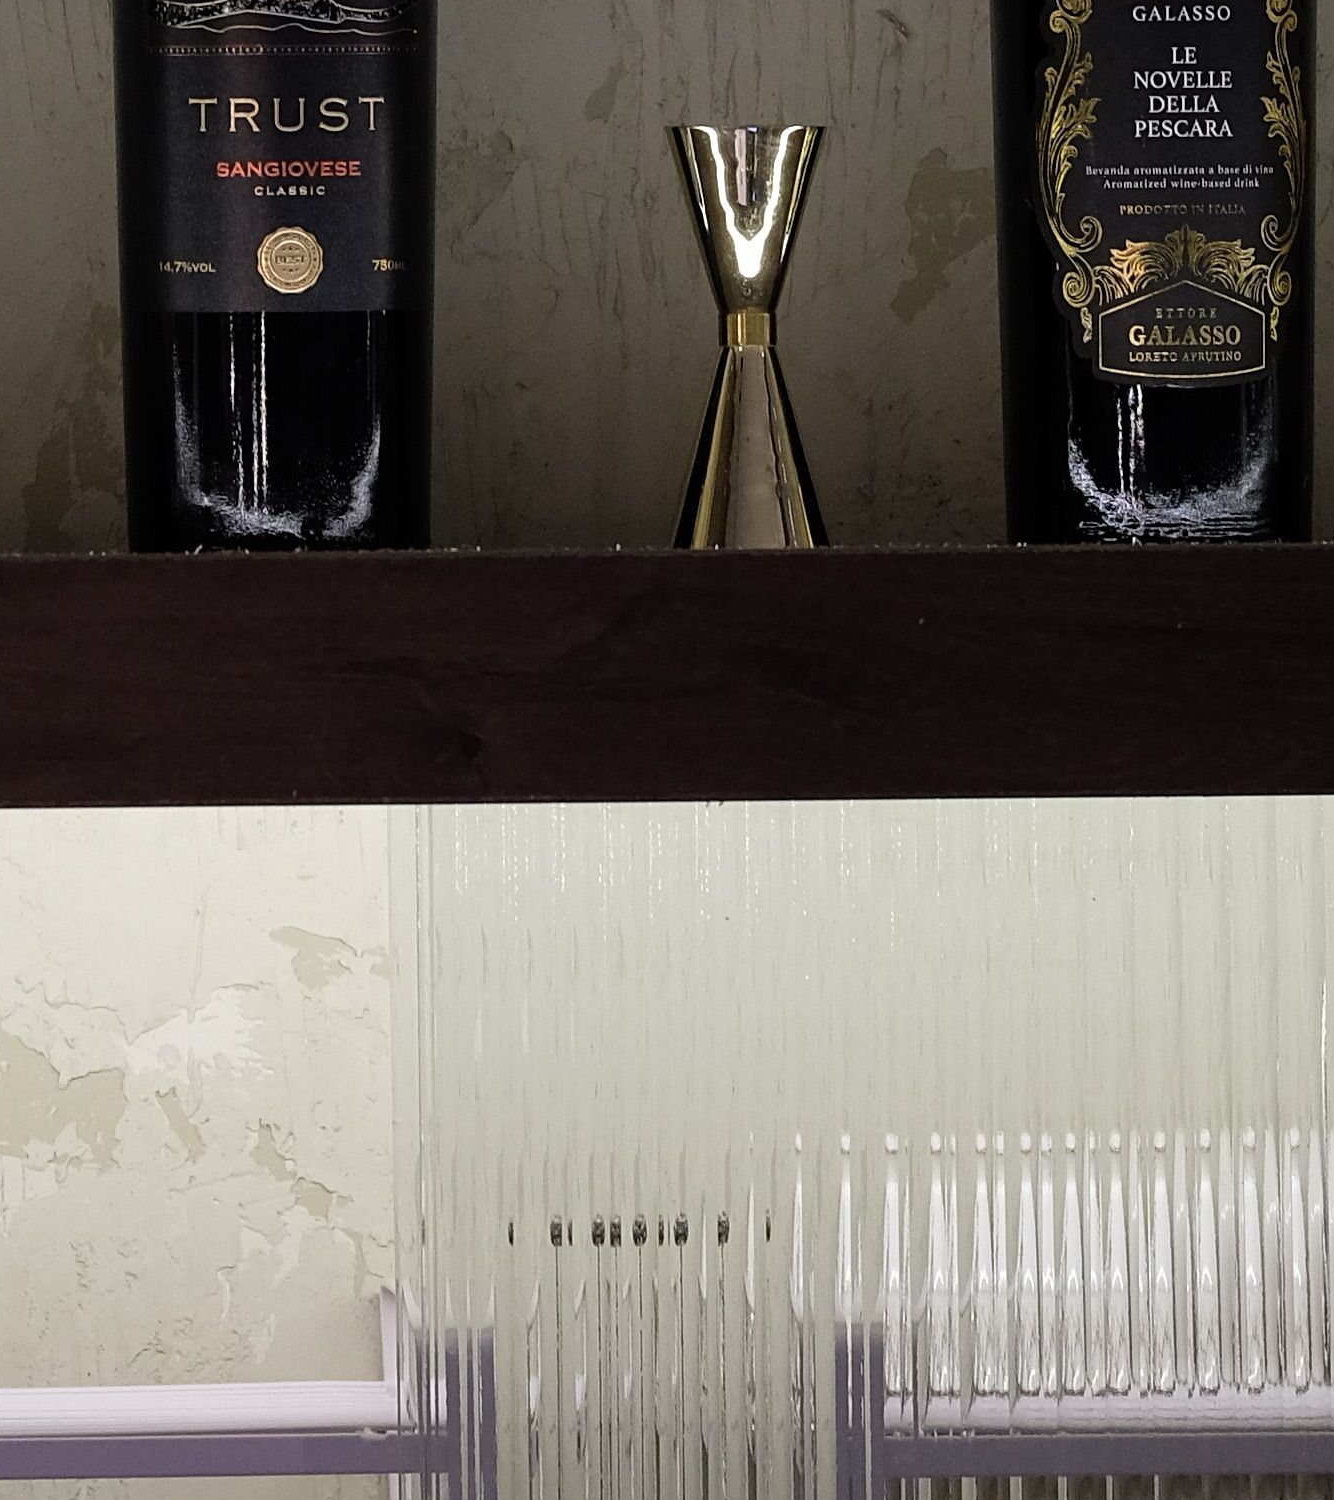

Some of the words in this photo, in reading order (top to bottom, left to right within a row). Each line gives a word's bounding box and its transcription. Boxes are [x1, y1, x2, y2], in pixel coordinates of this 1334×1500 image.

[1132, 4, 1232, 23] GALASSO
[1170, 47, 1197, 65] LE
[1133, 71, 1233, 90] NOVELLE
[1148, 95, 1220, 114] DELLA
[188, 96, 385, 133] TRUST
[1134, 119, 1234, 138] PESCARA
[216, 160, 362, 178] SANGIOVESE
[1085, 165, 1129, 177] Bevanda
[1217, 164, 1240, 175] base
[1242, 164, 1252, 174] di
[254, 185, 326, 196] CLASSIC
[1103, 178, 1167, 189] Aromatized
[1170, 177, 1231, 190] wine-based
[1234, 177, 1261, 188] drink
[1119, 203, 1187, 216] PRODOTTO
[1208, 203, 1247, 215] ITALIA
[1155, 307, 1217, 319] ETTORE
[1128, 324, 1241, 346] GALASSO
[1129, 351, 1178, 363] LORETO
